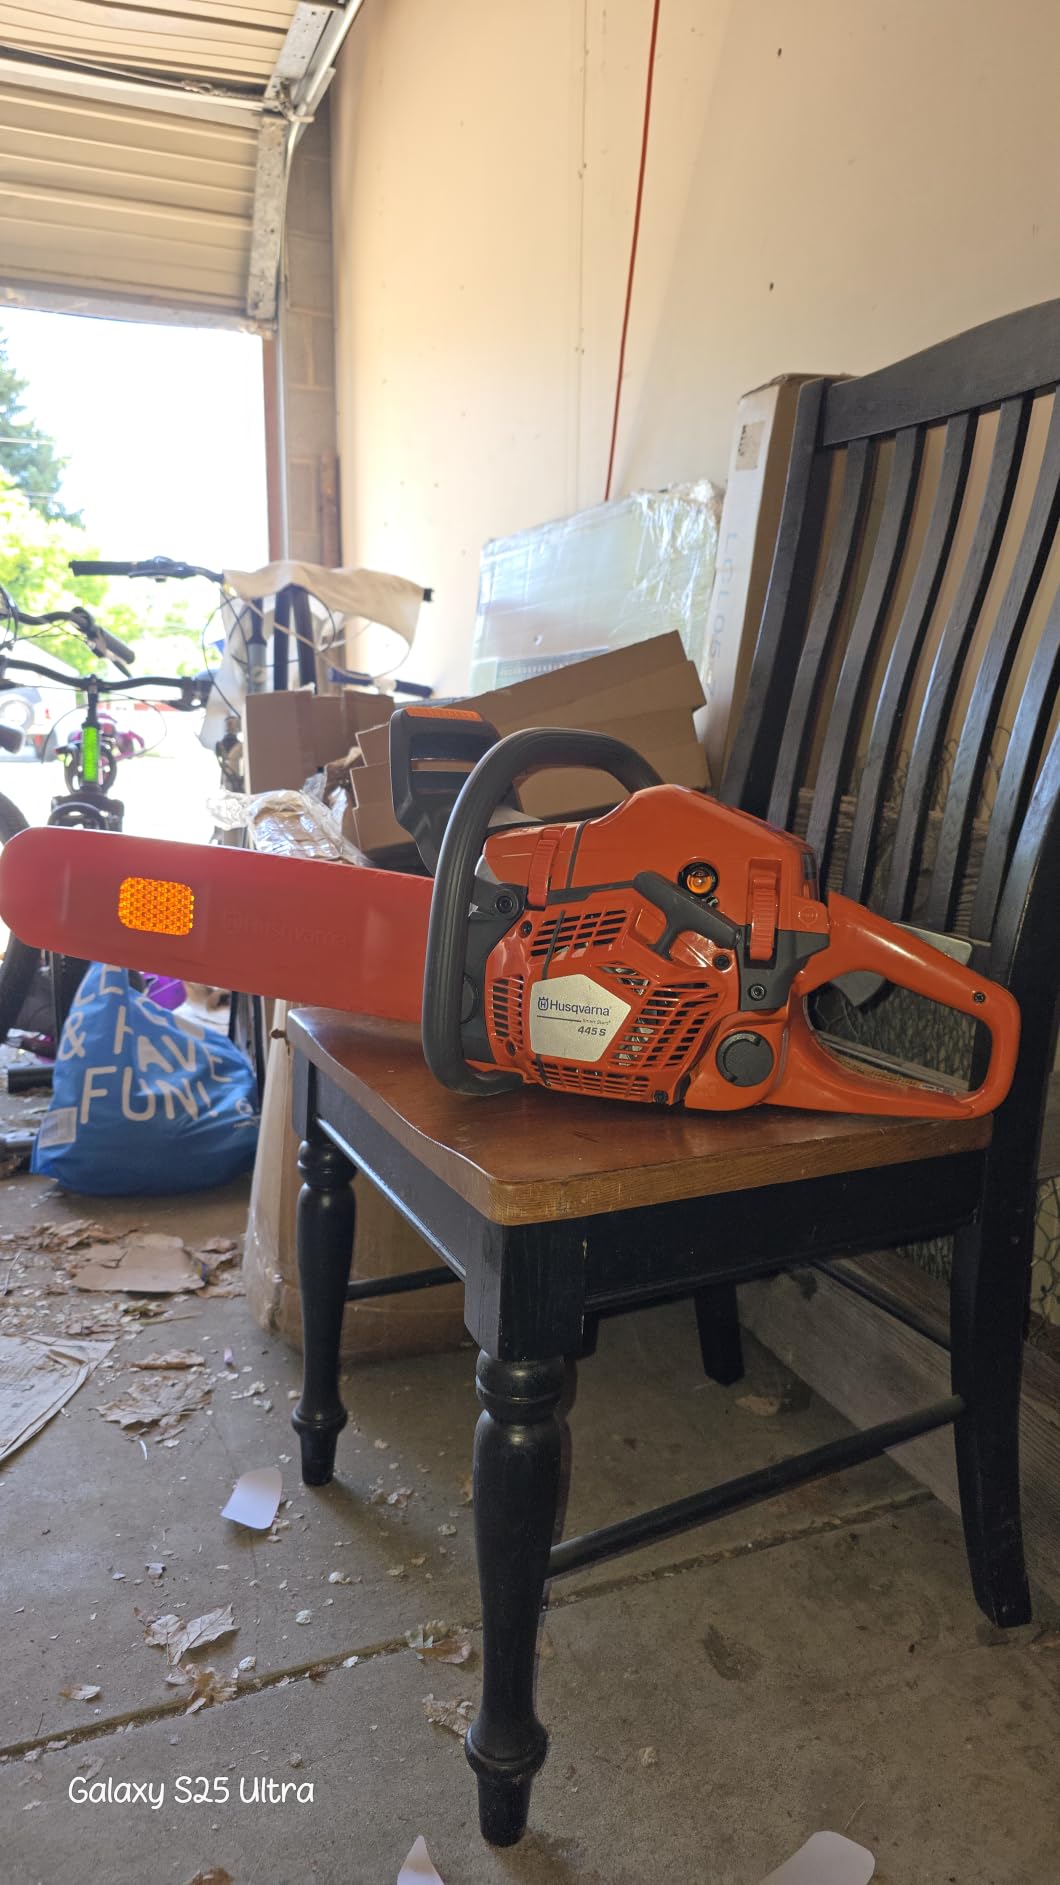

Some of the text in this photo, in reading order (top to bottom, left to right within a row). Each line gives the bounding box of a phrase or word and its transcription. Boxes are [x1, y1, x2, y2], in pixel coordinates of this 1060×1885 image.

[549, 1000, 610, 1016] Husqvarna
[59, 1011, 85, 1061] &
[577, 1025, 607, 1037] 445 S
